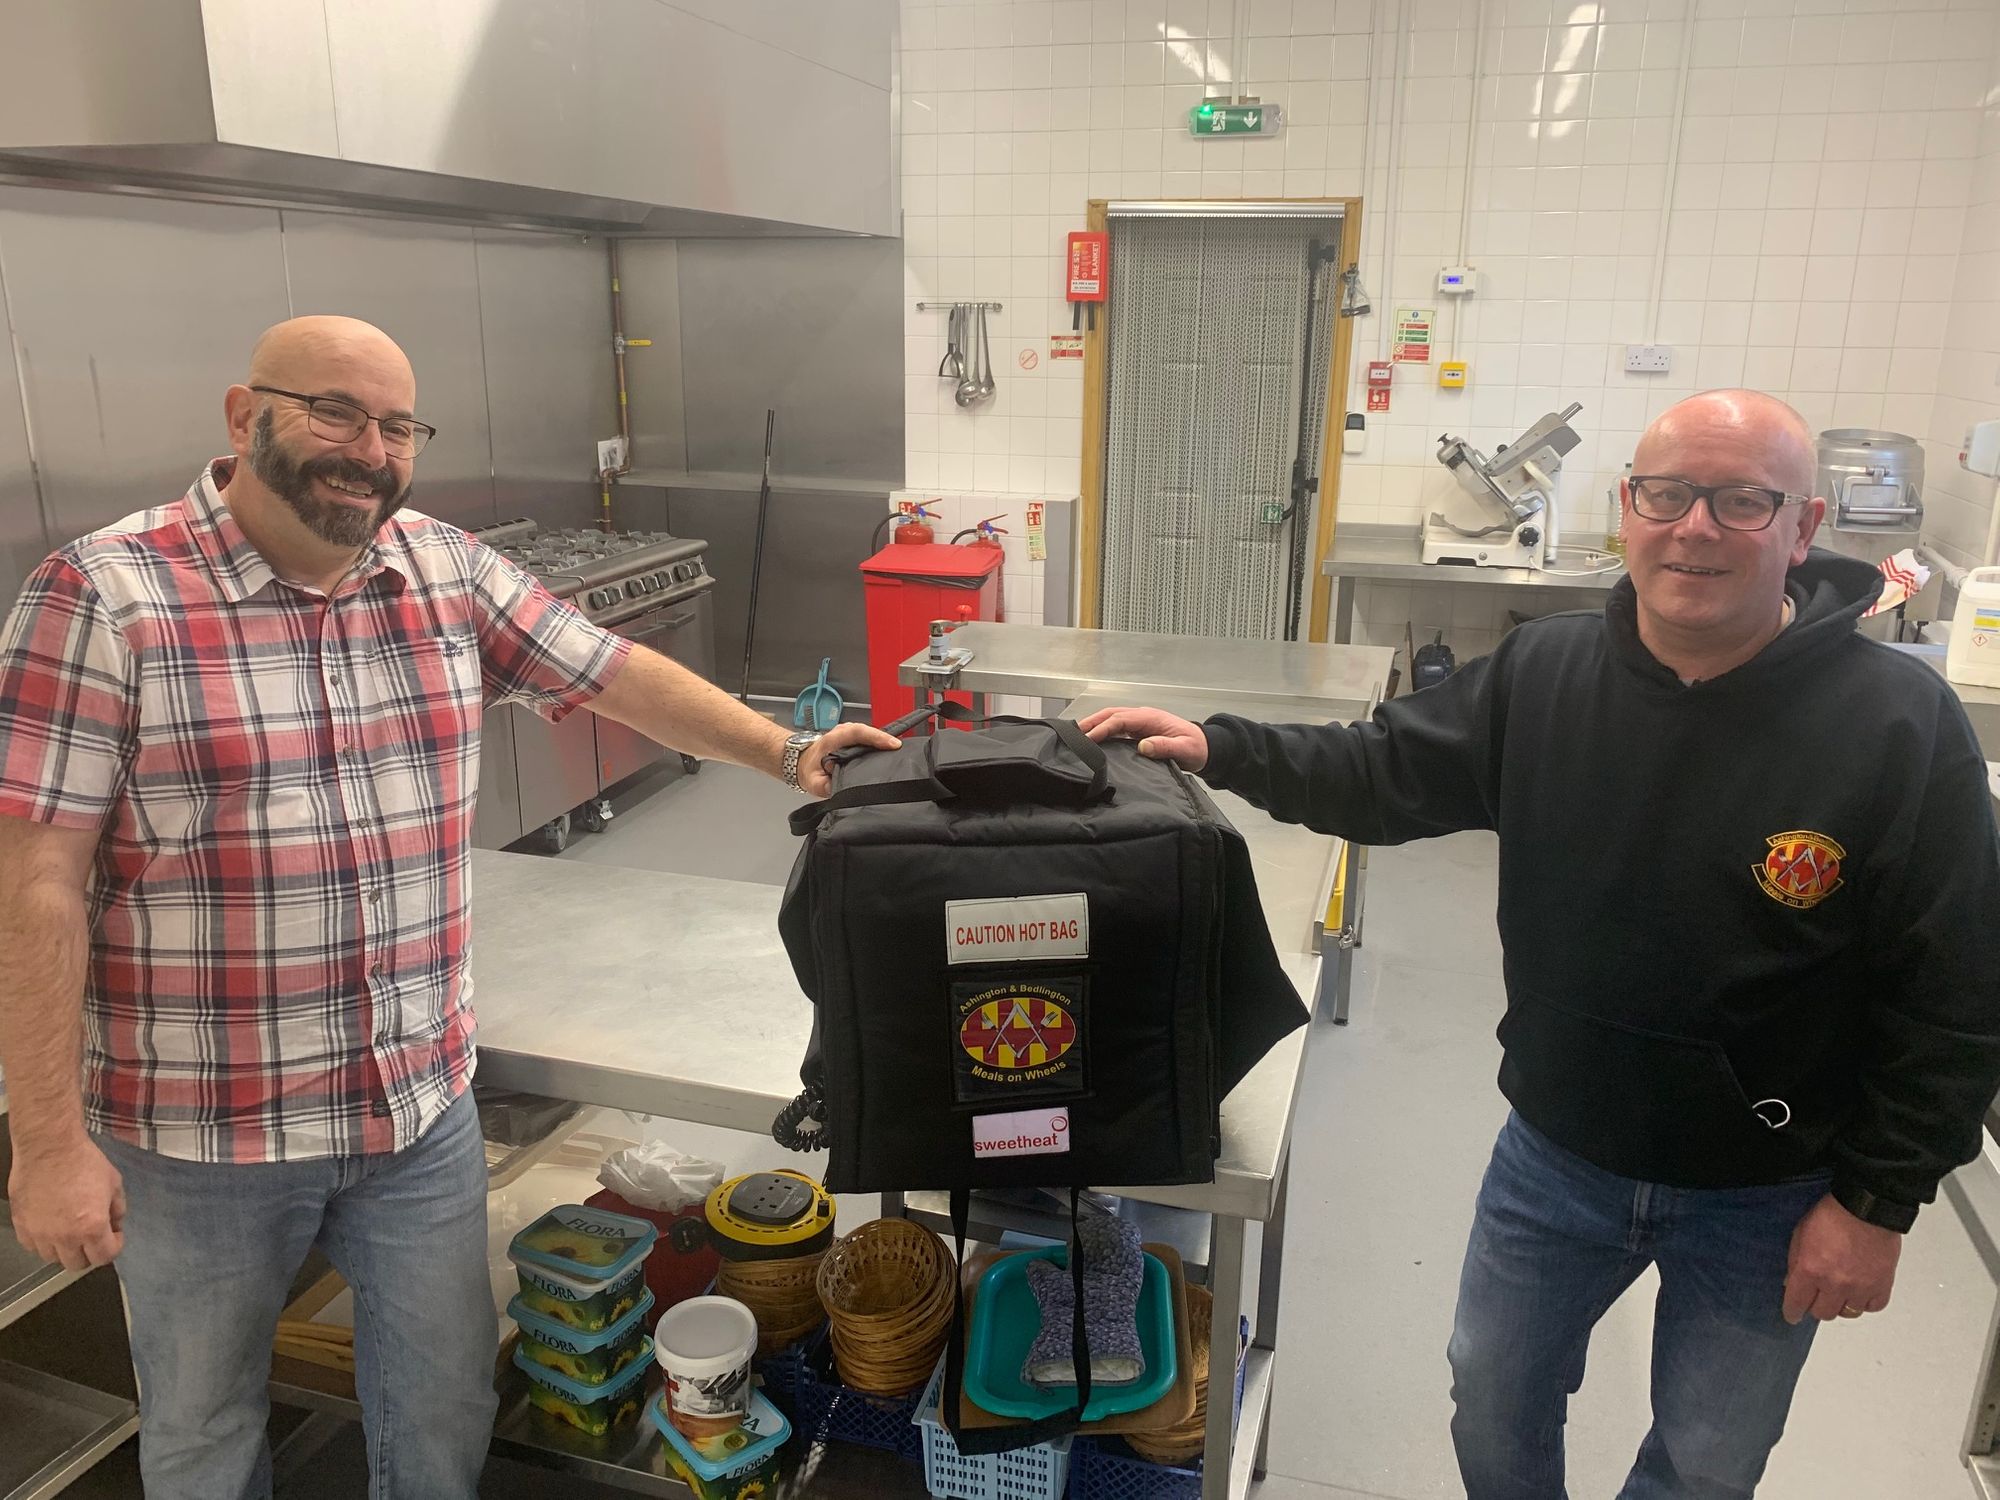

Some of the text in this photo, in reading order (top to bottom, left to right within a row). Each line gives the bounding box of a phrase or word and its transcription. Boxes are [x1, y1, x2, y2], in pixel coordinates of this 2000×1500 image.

[956, 919, 1078, 945] CAUTION HOT BAG
[960, 984, 1072, 1013] Ashington & Bedlington
[971, 1061, 1067, 1082] Meals on Wheels
[974, 1133, 1059, 1152] sweetheat
[566, 1217, 626, 1238] FLORA
[532, 1273, 577, 1301] FLORA
[610, 1267, 640, 1293] FLORA
[533, 1328, 579, 1354] FLORA
[732, 1453, 770, 1478] FLORA
